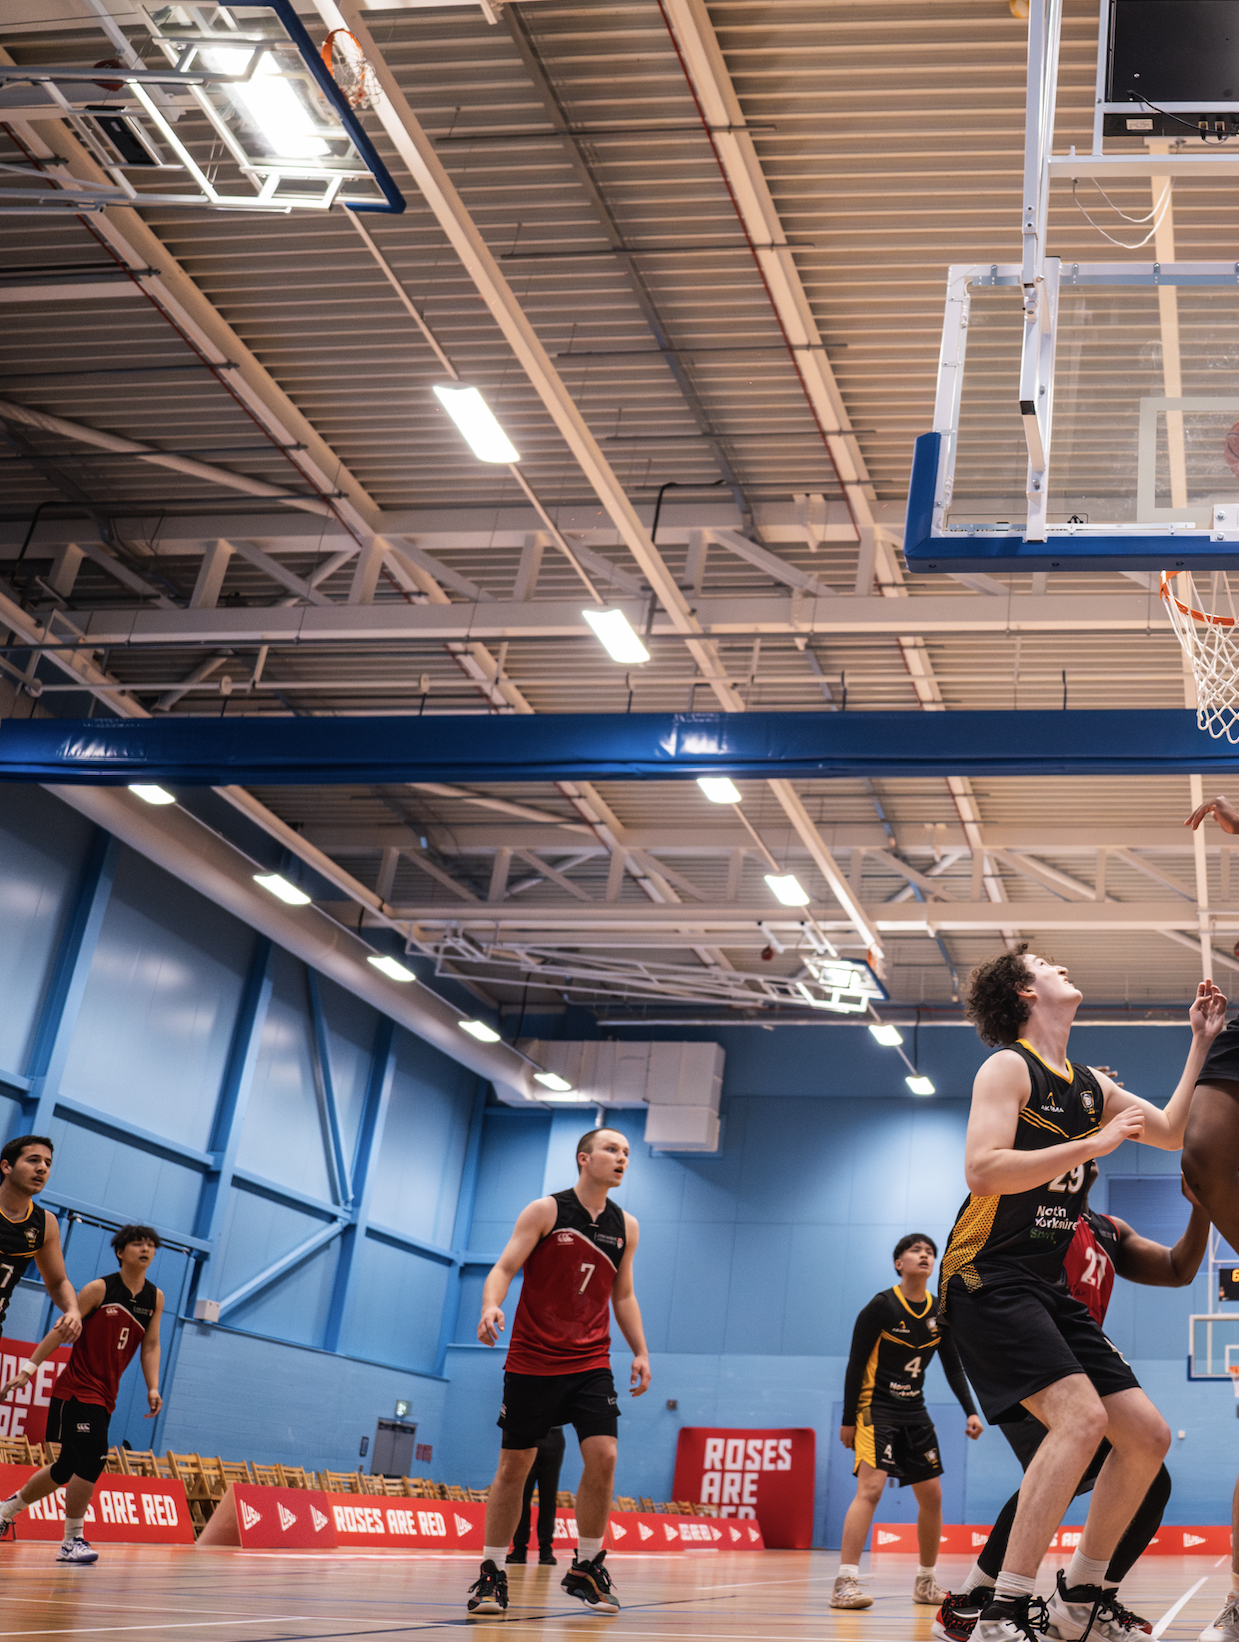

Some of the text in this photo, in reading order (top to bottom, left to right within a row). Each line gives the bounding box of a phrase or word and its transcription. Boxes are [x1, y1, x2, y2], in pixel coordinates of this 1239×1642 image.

[579, 1262, 596, 1295] 7
[117, 1327, 130, 1350] 9
[904, 1356, 922, 1379] 4
[703, 1437, 793, 1471] ROSES
[700, 1471, 759, 1504] ARE
[99, 1490, 140, 1525] ARE
[141, 1493, 179, 1527] RED
[333, 1505, 447, 1537] ROSES ARE RED
[1062, 1532, 1083, 1547] AR
